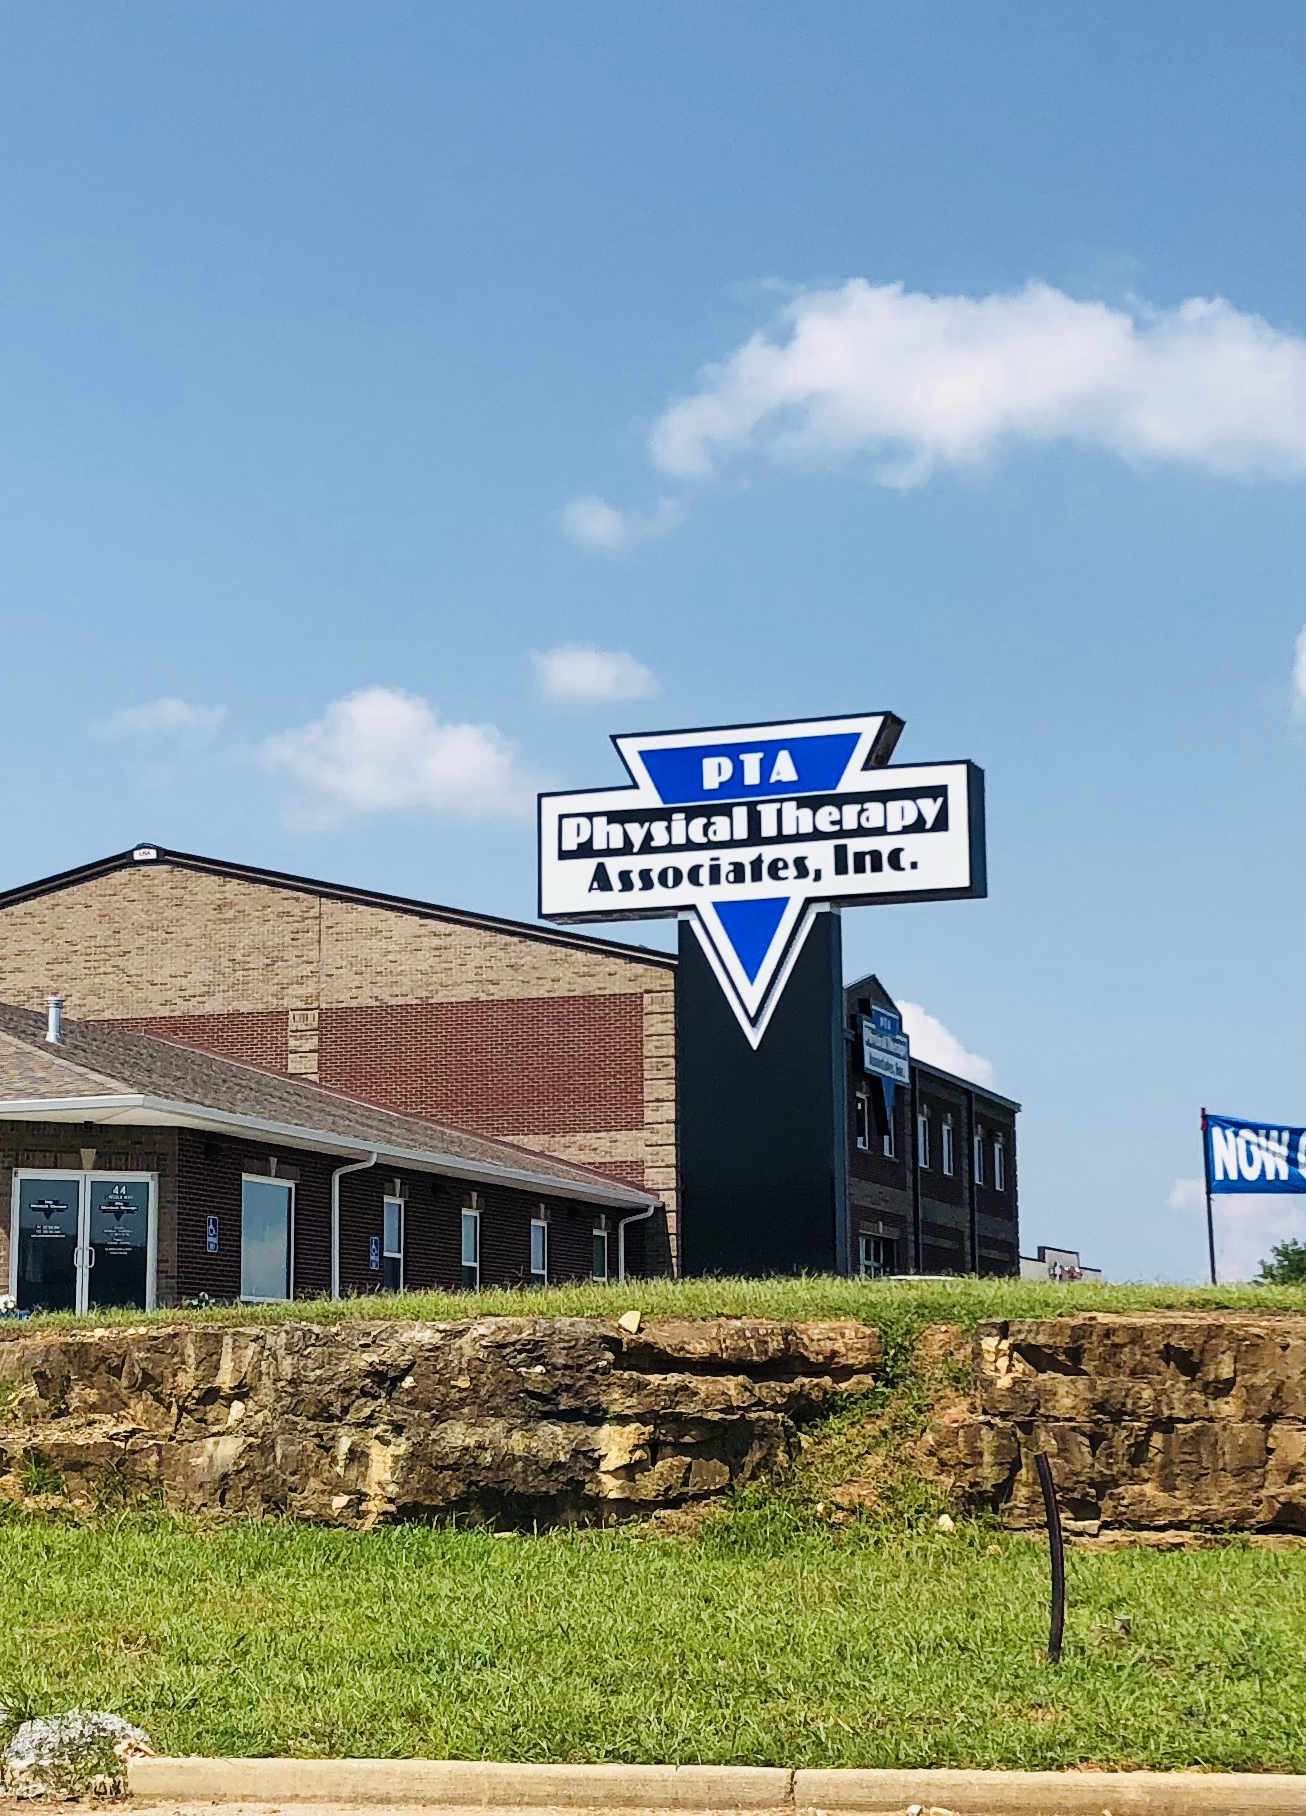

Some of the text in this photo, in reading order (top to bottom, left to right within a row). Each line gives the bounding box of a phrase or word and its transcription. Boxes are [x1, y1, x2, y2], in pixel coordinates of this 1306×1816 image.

[702, 750, 798, 790] PTA
[561, 796, 944, 853] Physical Therapy
[588, 843, 919, 893] Associates, Inc.
[1211, 1126, 1290, 1181] NOW
[112, 1185, 126, 1195] 44
